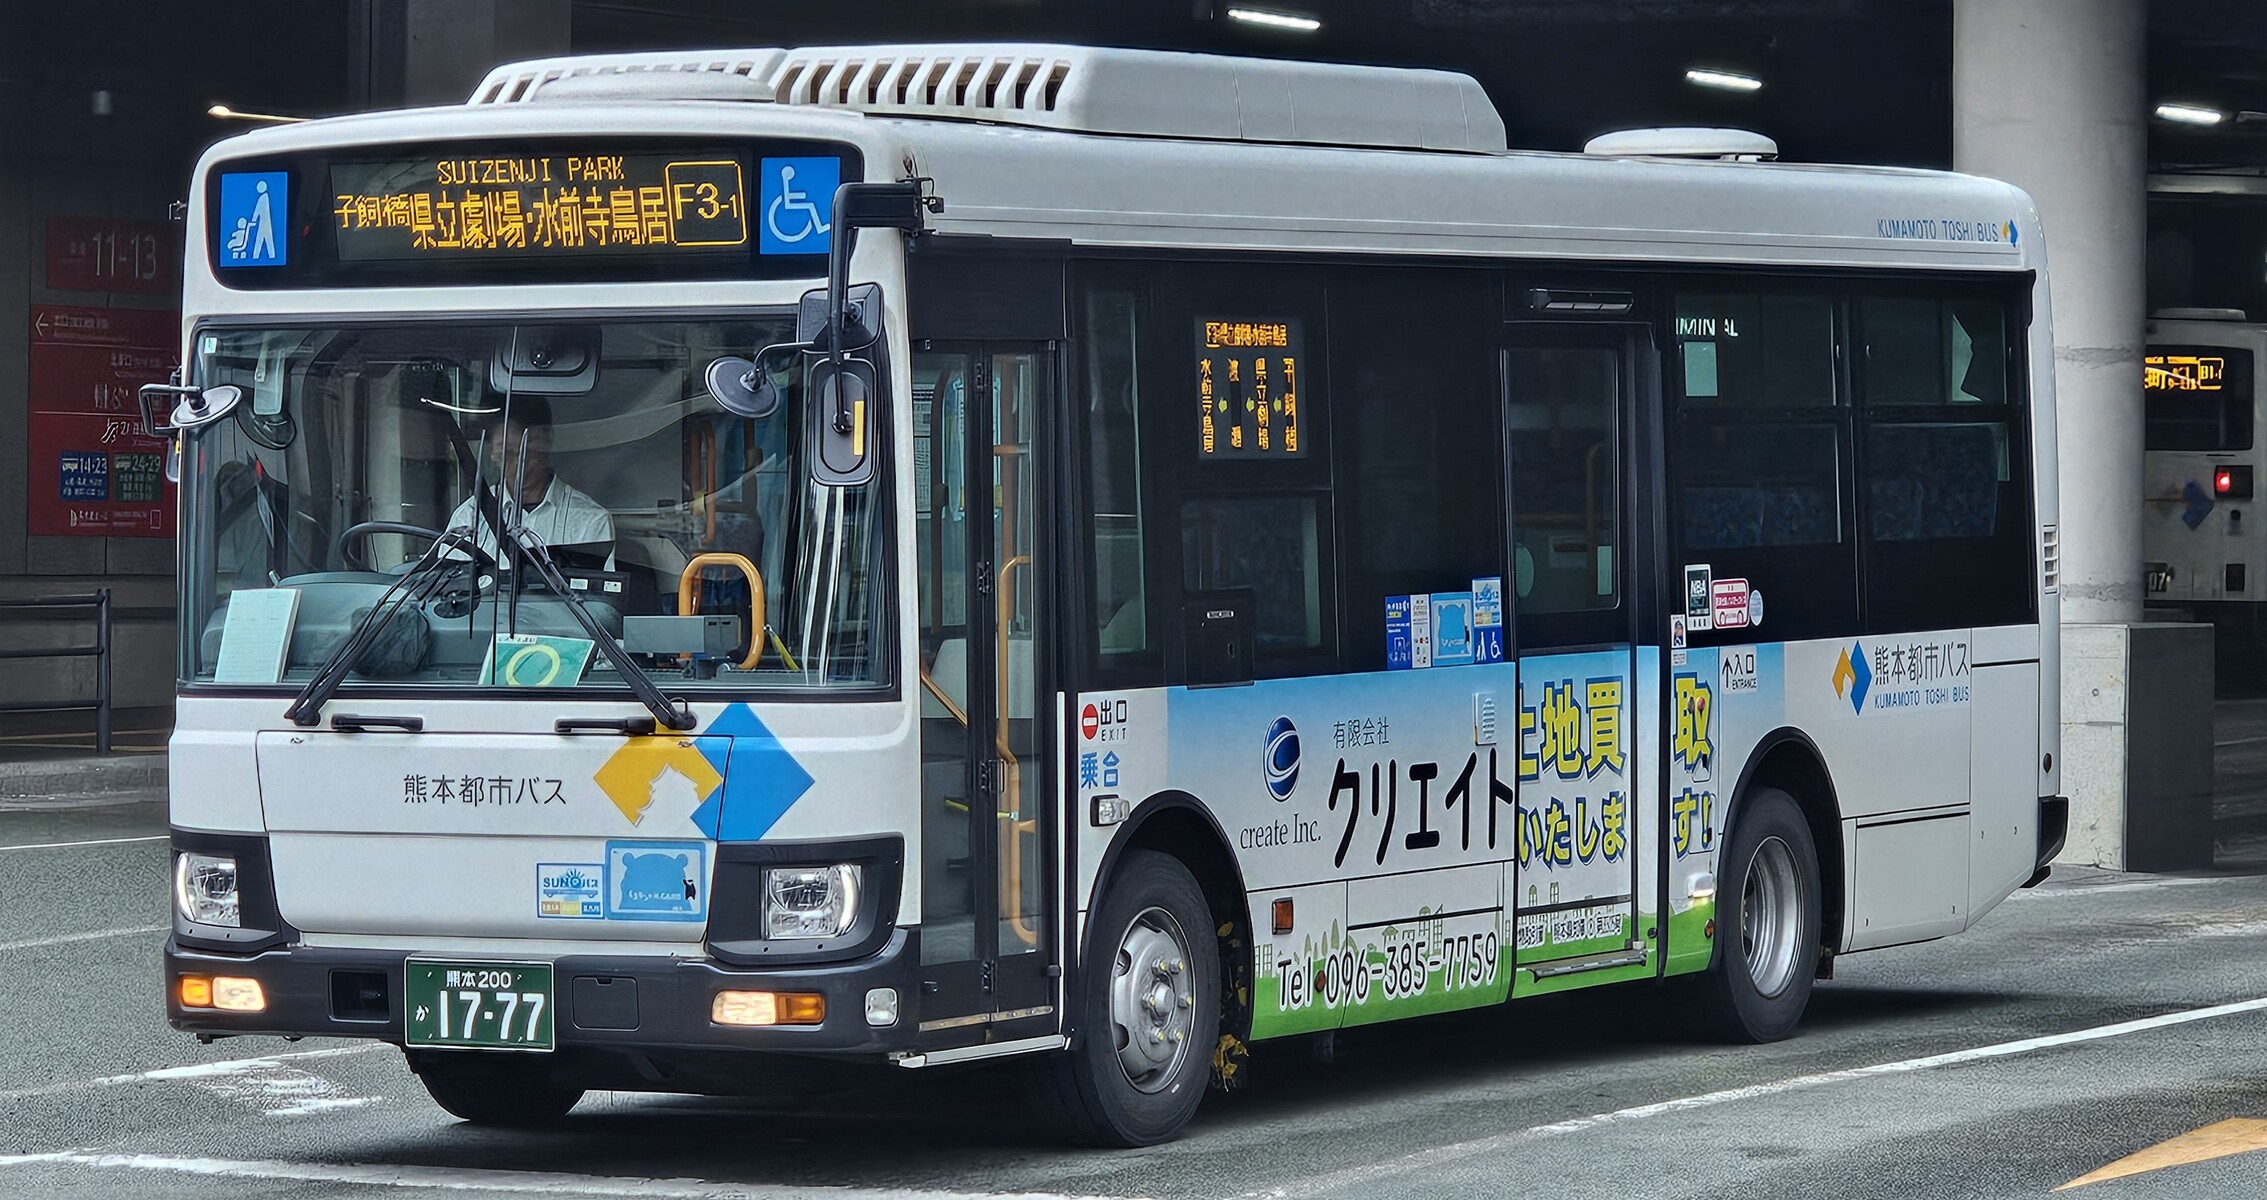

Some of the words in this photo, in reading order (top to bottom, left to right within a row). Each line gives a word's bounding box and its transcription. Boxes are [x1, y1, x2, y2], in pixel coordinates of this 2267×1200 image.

[437, 158, 551, 184] SUIZENJI
[567, 156, 625, 181] PARK
[674, 183, 738, 219] F3-1
[1876, 218, 1938, 240] KUMAMOTO
[1941, 219, 1974, 242] TOSHI
[1977, 222, 1999, 243] BUS
[91, 230, 157, 281] 11-13
[1734, 653, 1754, 675] 入口
[1875, 641, 1969, 686] 熊本都市バス
[1100, 699, 1127, 725] 出口
[1874, 690, 1920, 709] KUMAMOTO
[1925, 687, 1949, 706] TOSHI
[1952, 685, 1970, 702] BUS
[1101, 727, 1127, 742] EXIT
[1333, 716, 1390, 749] 有限会社
[1081, 750, 1120, 789] 乗合
[403, 773, 567, 808] 熊本都市バス
[1328, 747, 1513, 869] クリエイト
[1240, 818, 1288, 850] create
[1292, 812, 1322, 844] Inc.
[1278, 958, 1313, 1010] Tel
[1325, 930, 1498, 1006] 096-385-7759
[415, 1004, 430, 1022] か
[439, 990, 546, 1042] 17-77
